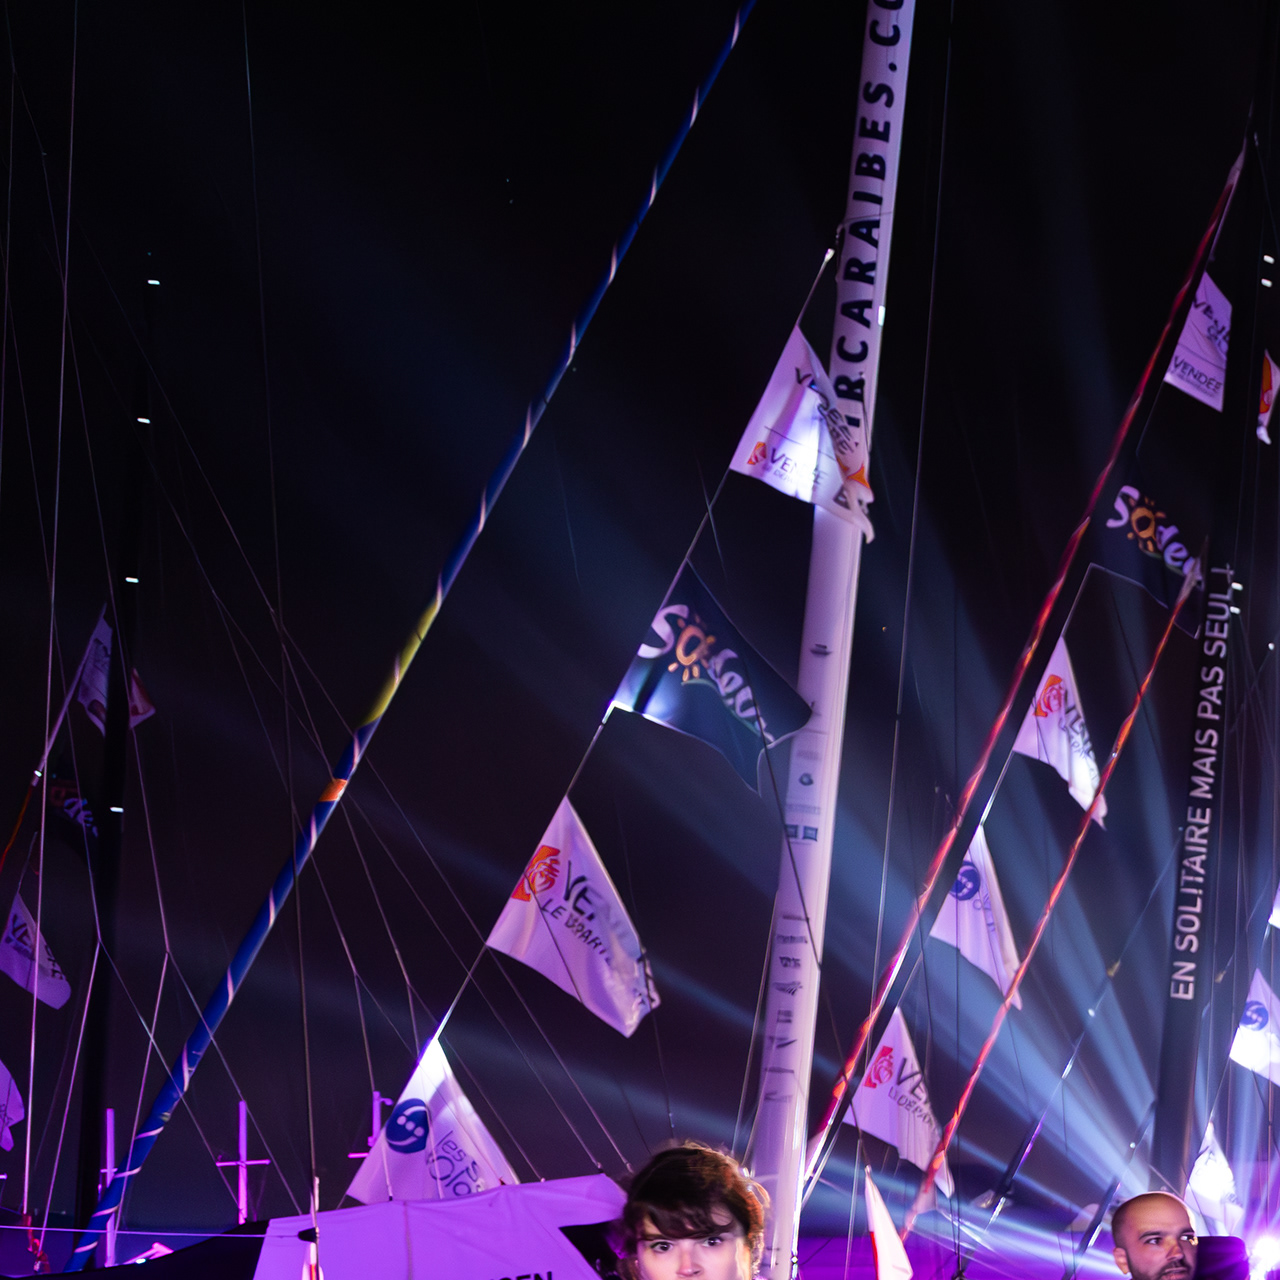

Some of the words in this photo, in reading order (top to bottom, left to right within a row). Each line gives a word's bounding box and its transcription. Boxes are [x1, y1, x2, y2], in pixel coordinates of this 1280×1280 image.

[1202, 586, 1233, 660] SEUL
[1196, 666, 1225, 720] PAS
[1189, 729, 1220, 799] MAIS
[1174, 806, 1212, 954] SOLITAIRE
[1169, 961, 1197, 1000] EN
